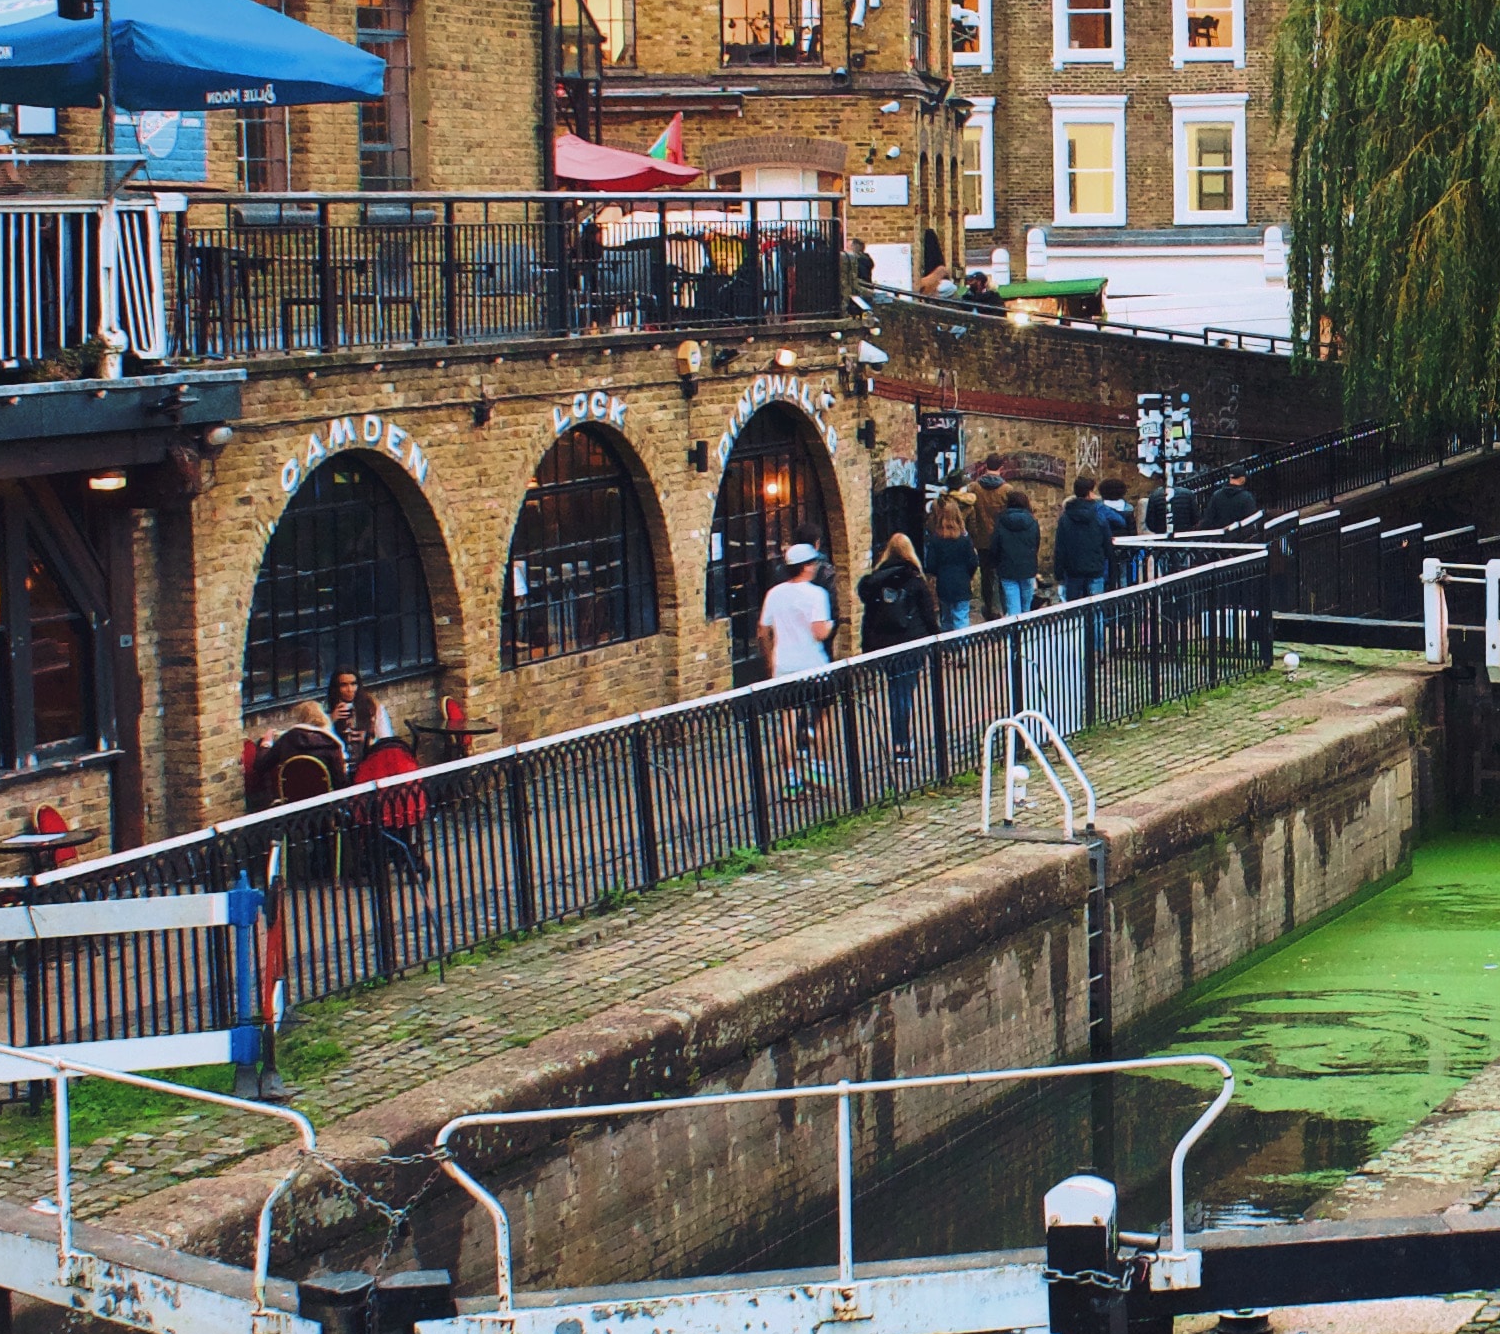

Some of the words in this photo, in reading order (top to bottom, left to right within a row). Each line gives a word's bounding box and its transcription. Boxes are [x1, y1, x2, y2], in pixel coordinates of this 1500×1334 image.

[280, 414, 430, 493] CAMDEN
[553, 391, 629, 435] LOCK
[717, 374, 838, 468] DINGWALLS
